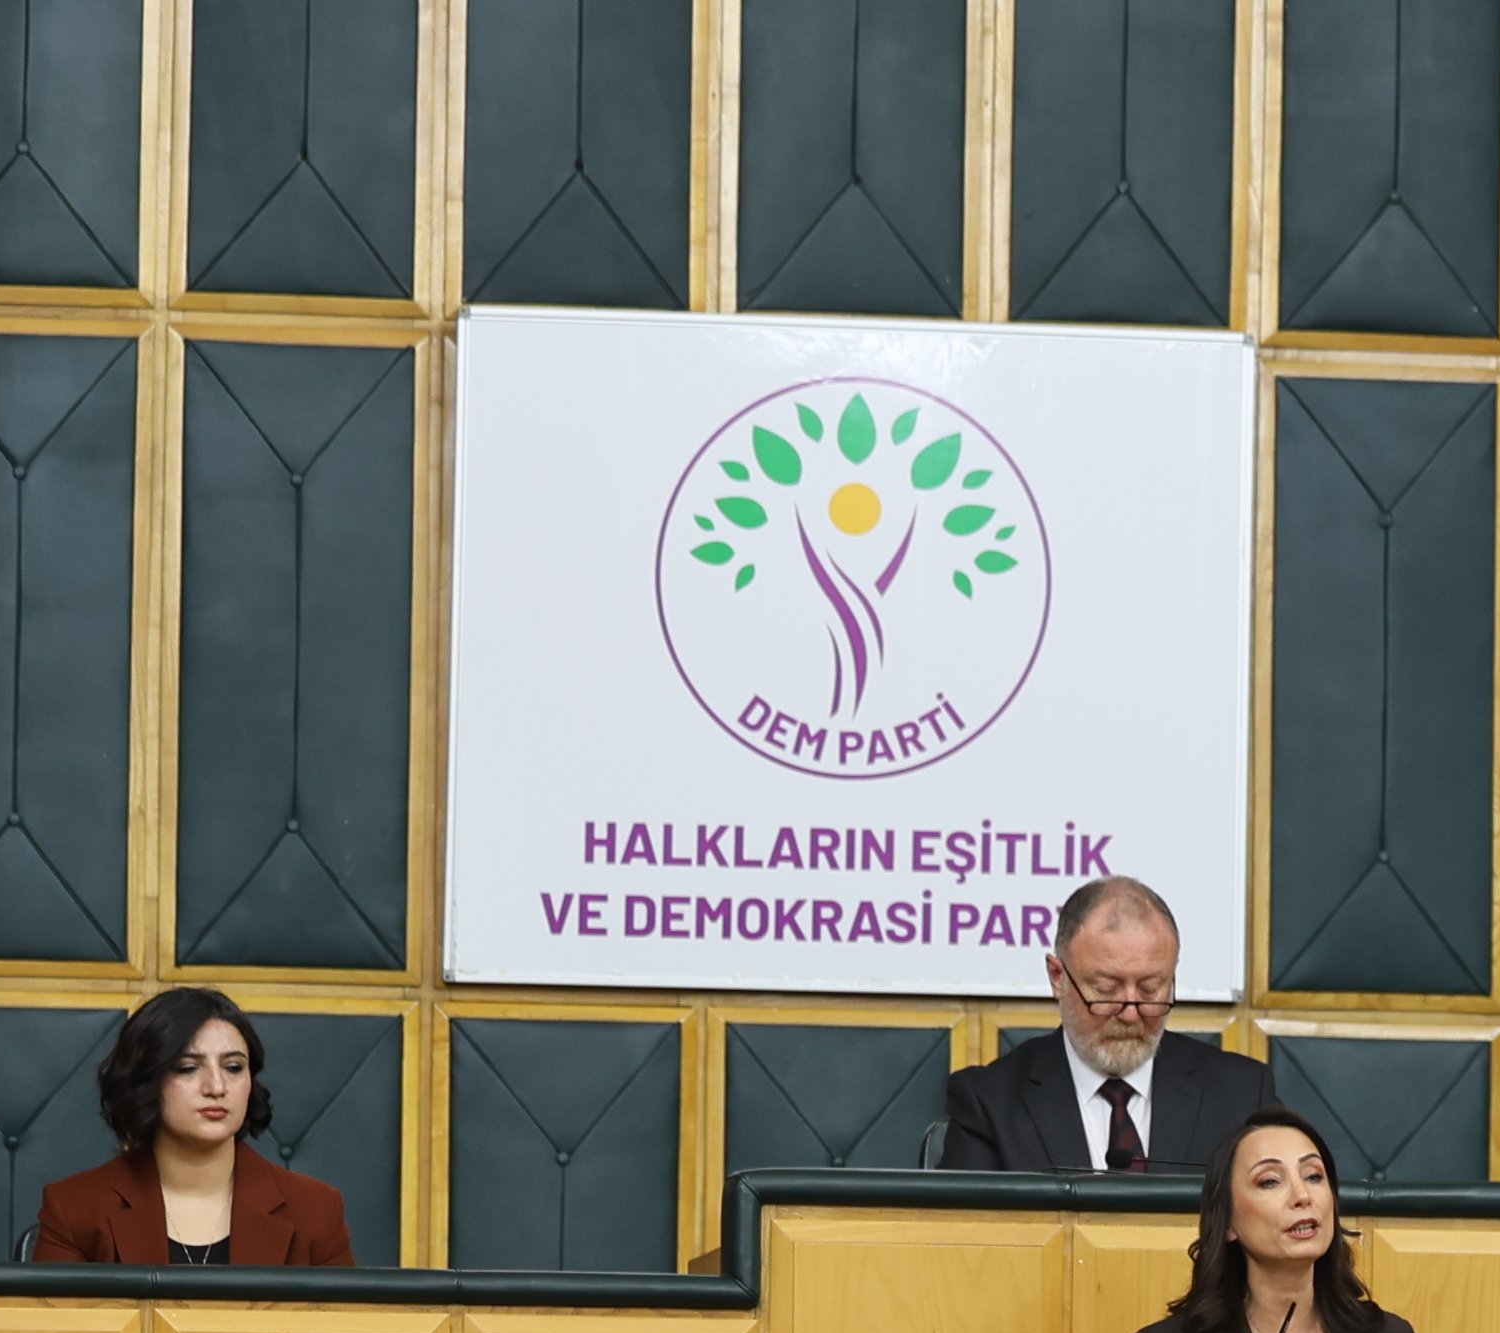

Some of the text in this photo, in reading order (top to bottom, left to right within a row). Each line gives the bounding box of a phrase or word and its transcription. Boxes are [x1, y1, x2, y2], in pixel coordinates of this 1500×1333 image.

[736, 692, 967, 766] DEM PARTİ
[584, 818, 1113, 884] HALKLARIN EŞİTLİK
[541, 891, 608, 937] VE
[624, 888, 933, 945] DEMOKRASİ
